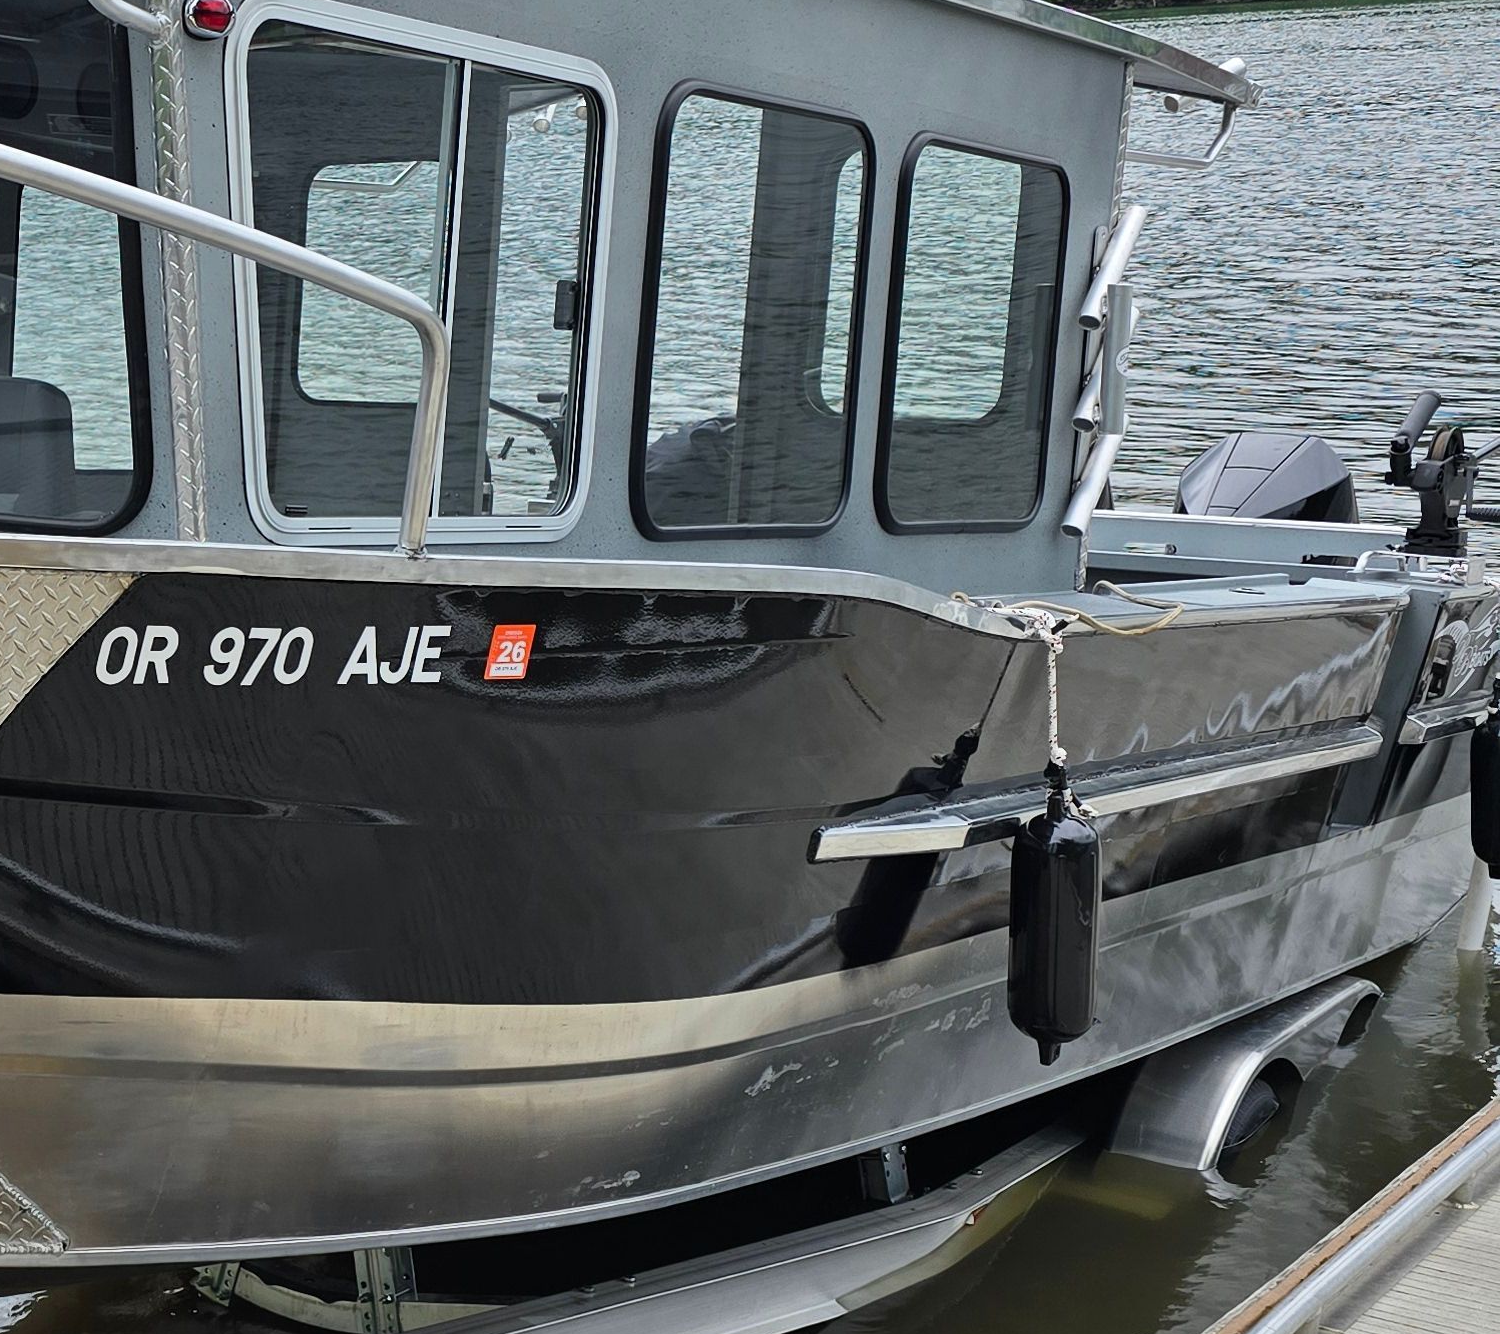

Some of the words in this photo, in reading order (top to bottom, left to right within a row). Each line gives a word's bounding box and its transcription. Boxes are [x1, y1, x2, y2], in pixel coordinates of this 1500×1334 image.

[95, 625, 179, 685] OR
[203, 626, 314, 685] 970
[337, 624, 452, 685] AJE
[496, 640, 527, 663] 26
